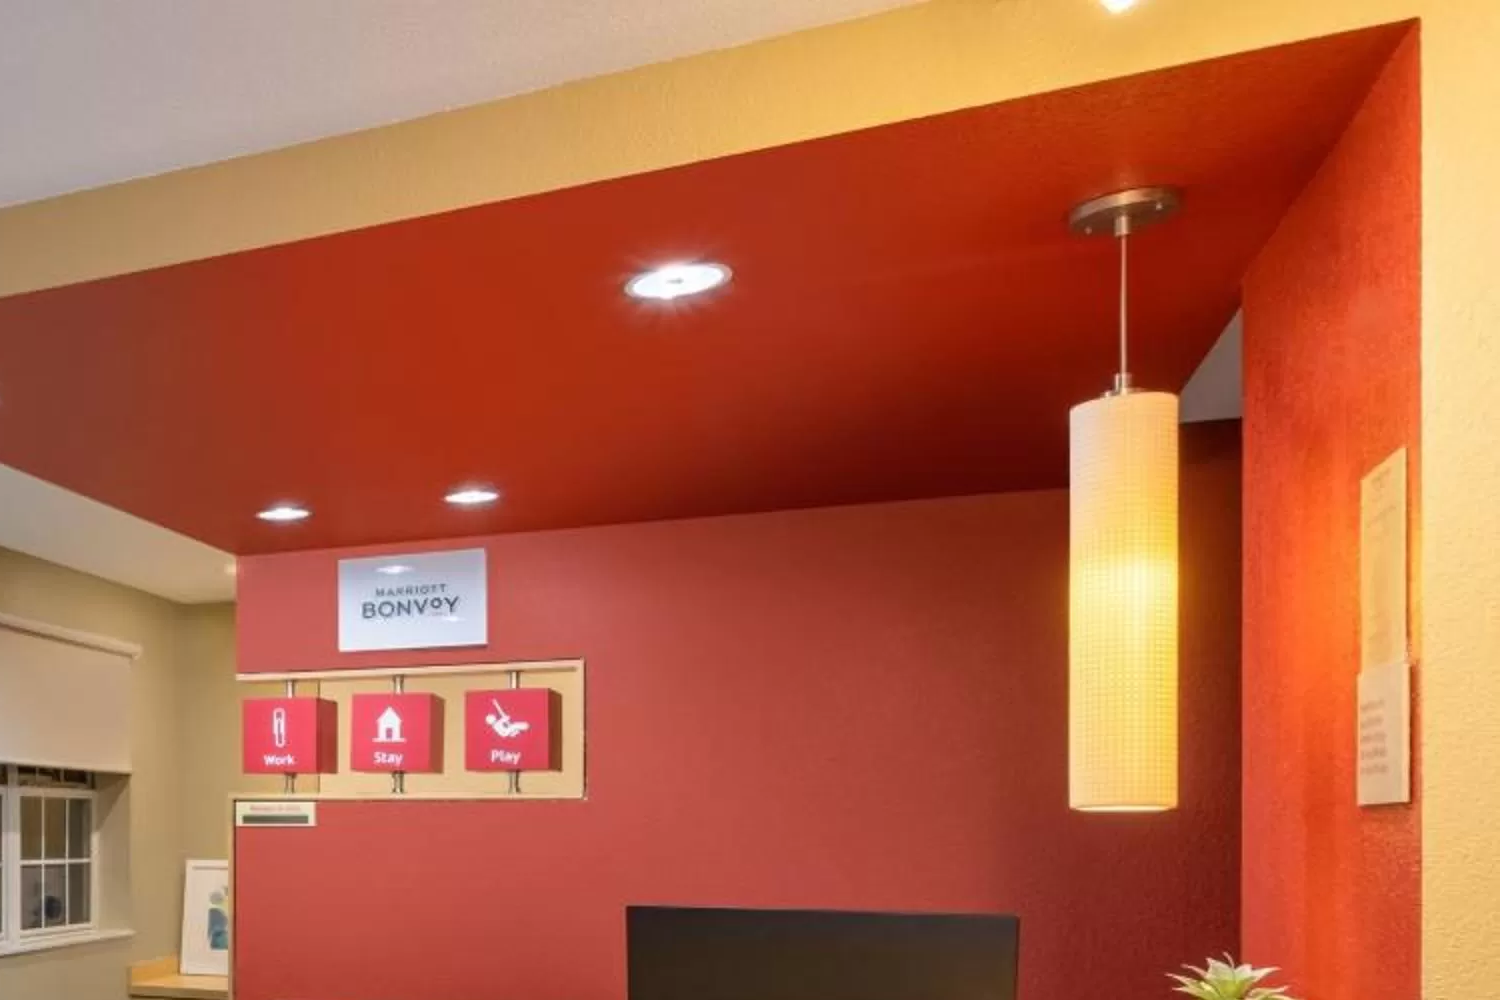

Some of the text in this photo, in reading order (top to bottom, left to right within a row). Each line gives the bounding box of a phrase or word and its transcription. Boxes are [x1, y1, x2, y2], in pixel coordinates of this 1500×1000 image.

[375, 583, 447, 597] MARRIOTT
[361, 595, 460, 619] BONVOY
[264, 754, 296, 767] Work
[373, 751, 404, 766] Stay
[491, 749, 522, 766] Play
